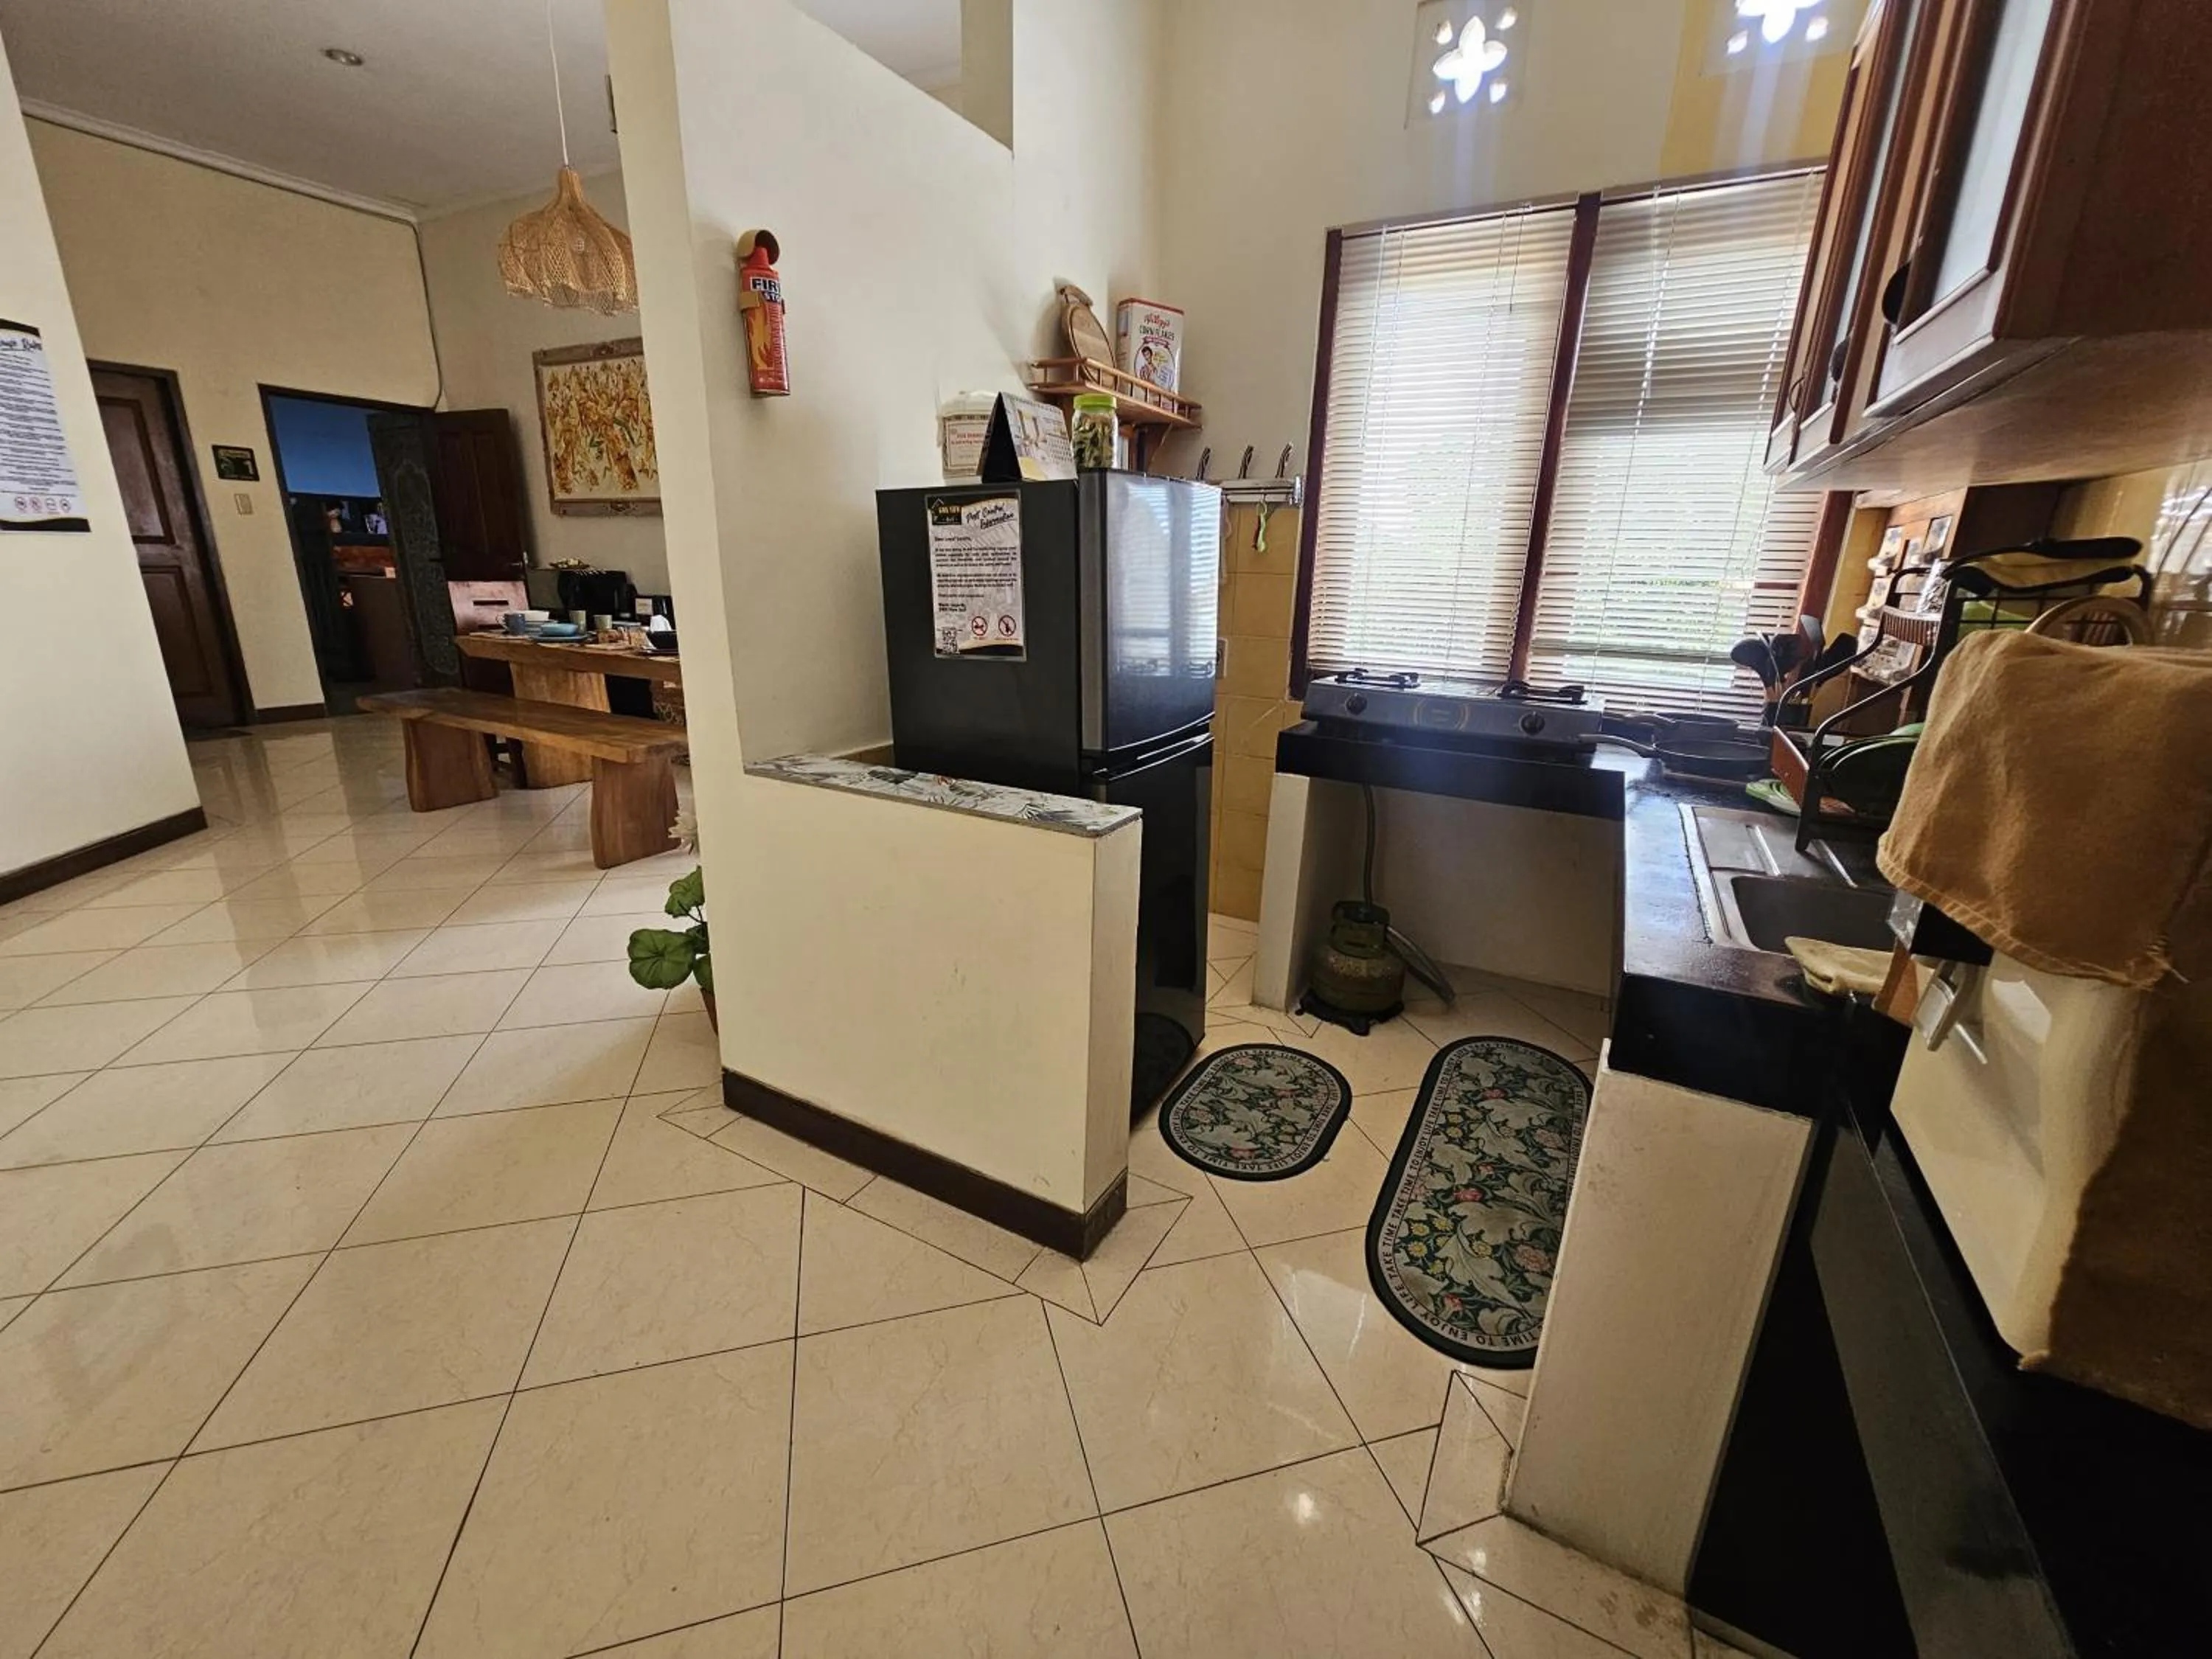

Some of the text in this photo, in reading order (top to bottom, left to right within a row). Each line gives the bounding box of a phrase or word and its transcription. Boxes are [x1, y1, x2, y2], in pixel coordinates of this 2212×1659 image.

[1414, 1135, 1428, 1158] ENJOY
[1409, 1158, 1420, 1171] TO
[1401, 1173, 1416, 1195] TIME
[1391, 1197, 1406, 1220] TAKE
[1382, 1222, 1397, 1247] TIME
[1382, 1251, 1399, 1280] TAKE
[1394, 1284, 1419, 1310] LIFE
[1419, 1312, 1468, 1341] ENJOY
[1475, 1335, 1497, 1347] TO
